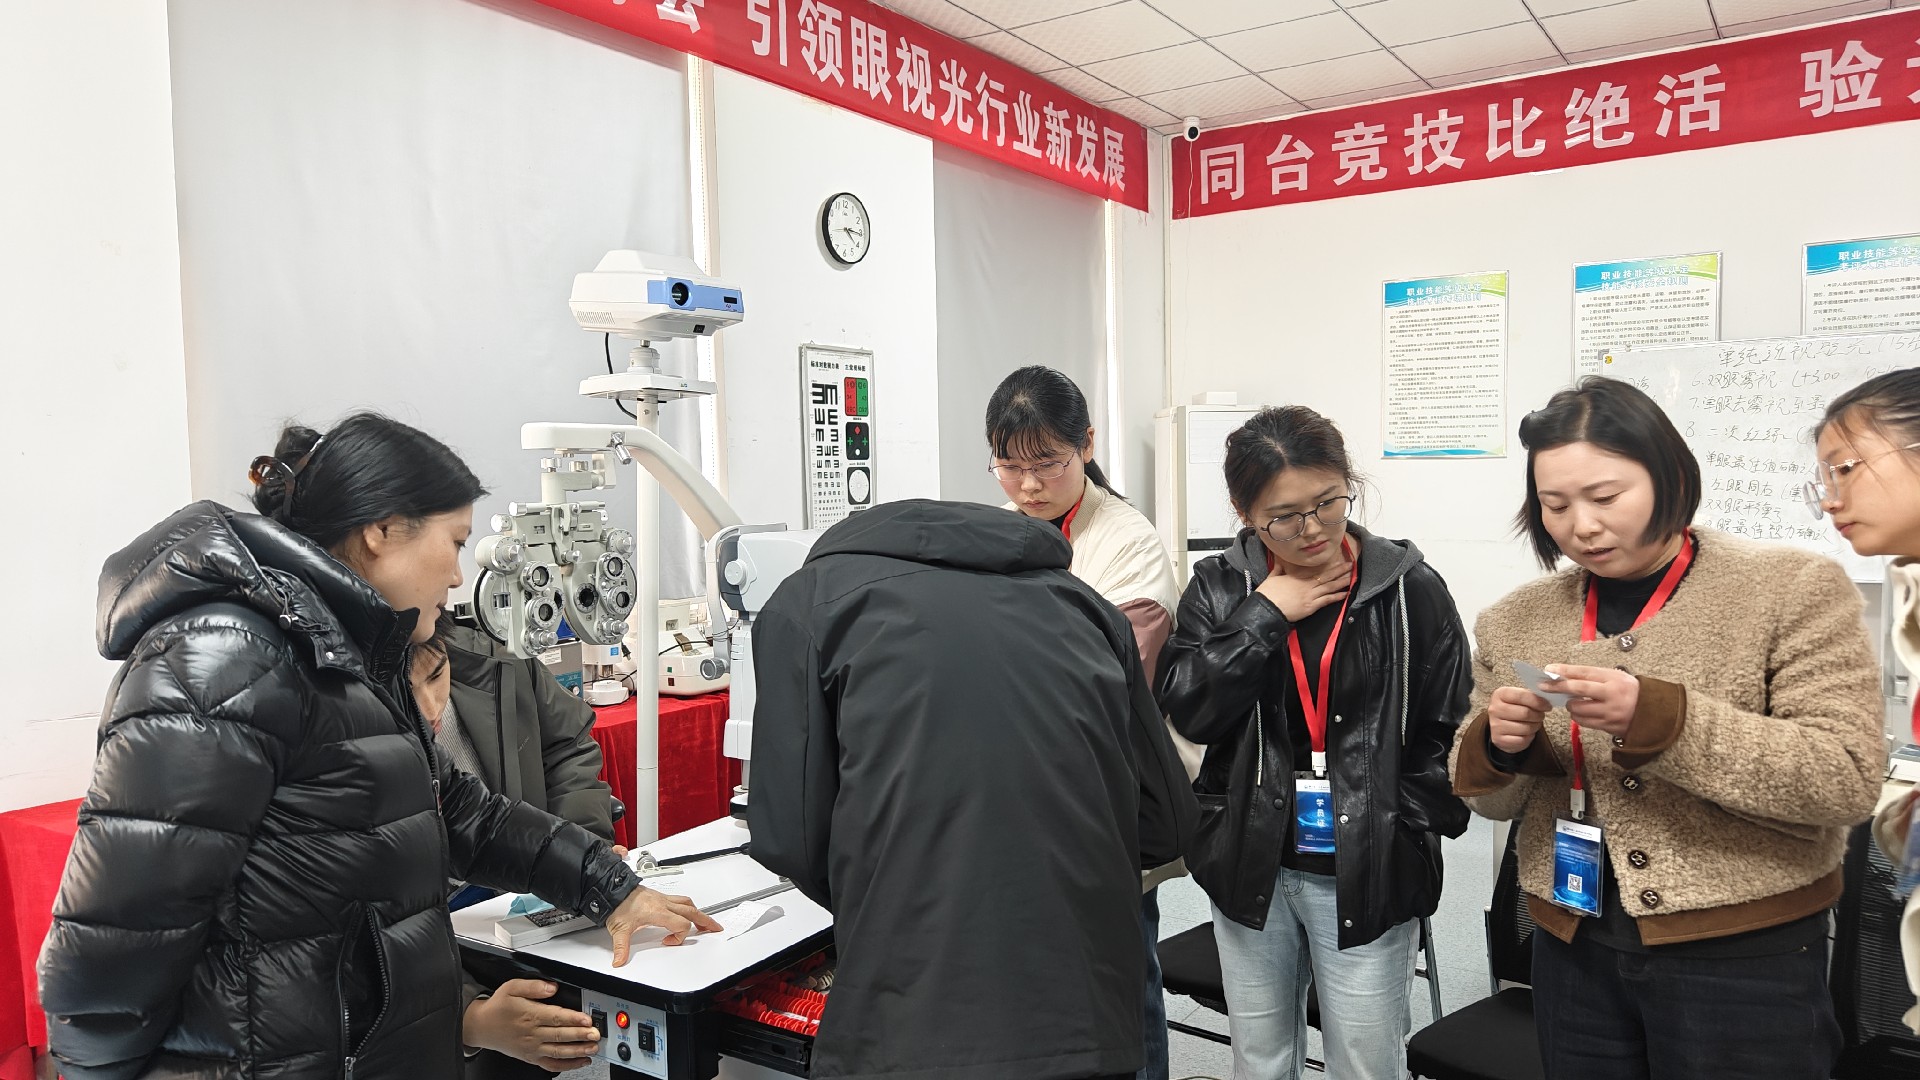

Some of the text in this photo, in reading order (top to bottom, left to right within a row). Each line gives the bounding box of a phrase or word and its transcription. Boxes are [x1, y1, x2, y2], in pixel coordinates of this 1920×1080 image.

[747, 0, 1126, 191] 引领眼视光行业新发展
[1200, 40, 1920, 205] 同台竞技比绝活 验
[843, 200, 849, 209] 12
[856, 217, 861, 225] 2
